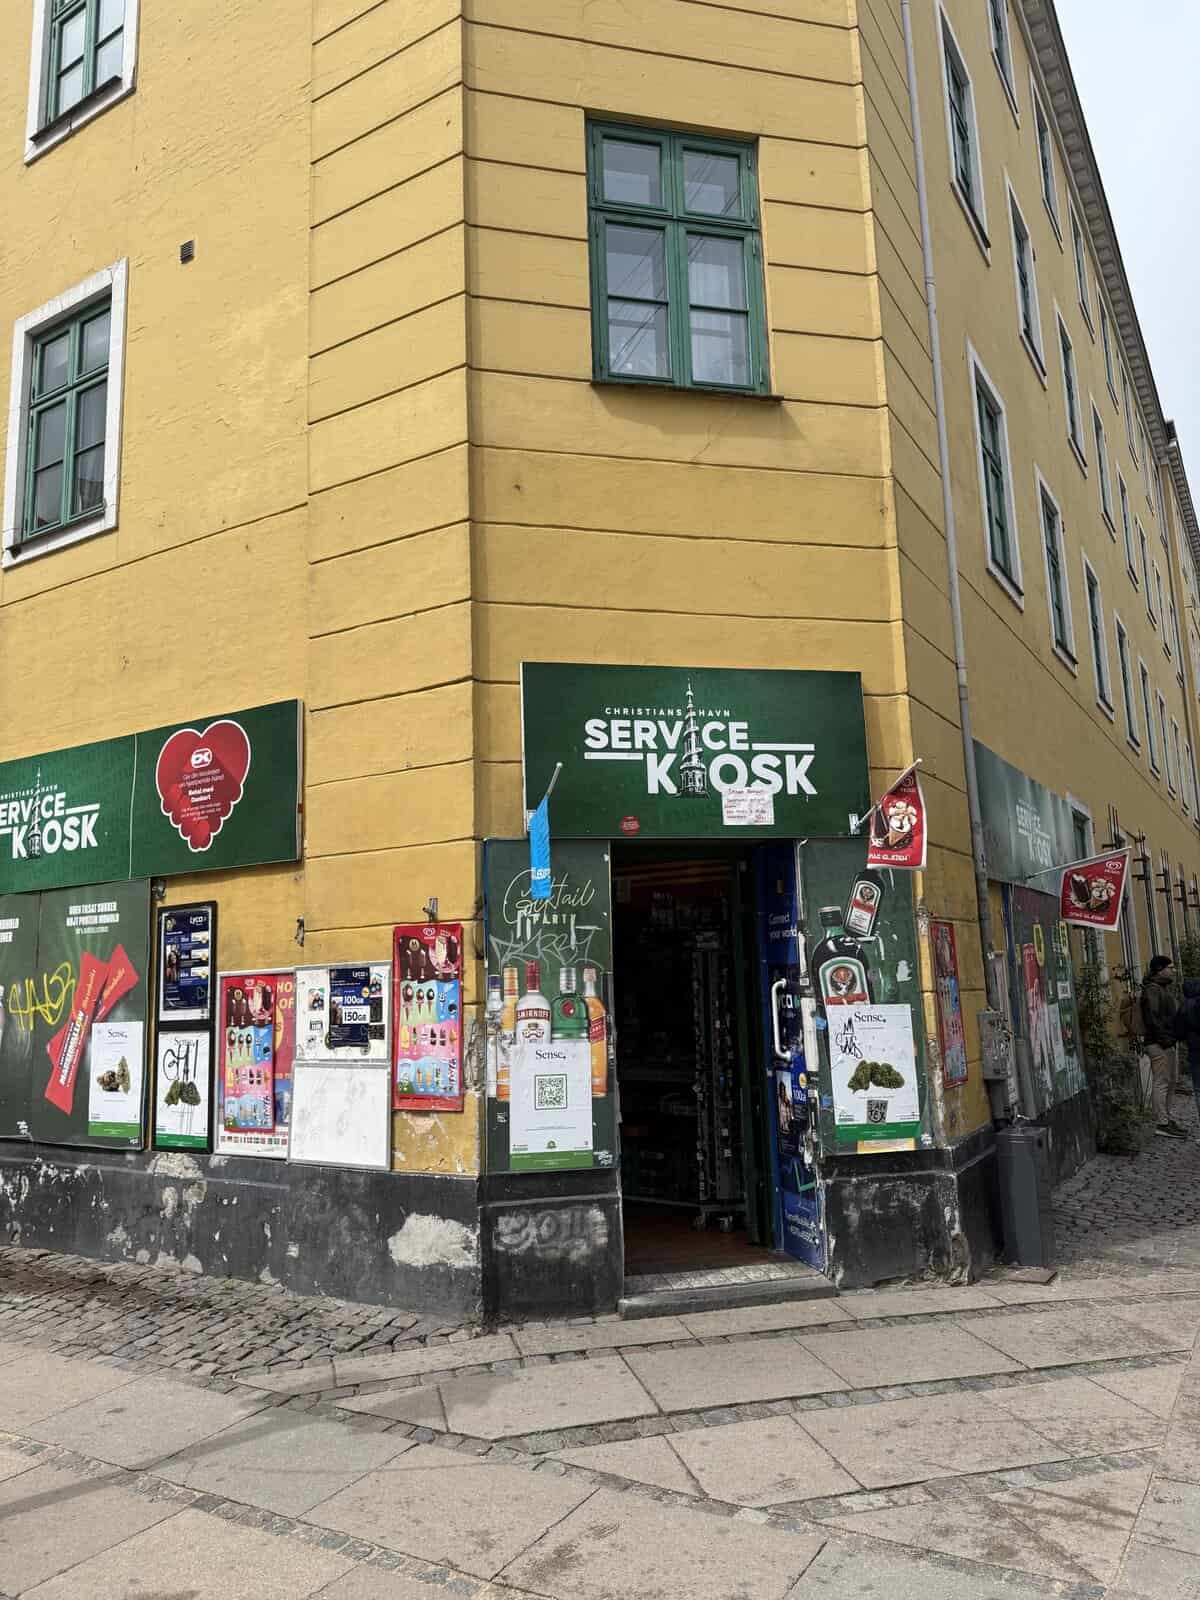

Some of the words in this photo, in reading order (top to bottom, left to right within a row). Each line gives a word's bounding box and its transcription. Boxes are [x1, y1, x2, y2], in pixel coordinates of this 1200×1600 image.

[584, 719, 749, 750] SERVICE
[646, 752, 817, 796] KIOSK
[0, 792, 66, 826] ERVICE
[12, 812, 99, 859] KIOSK
